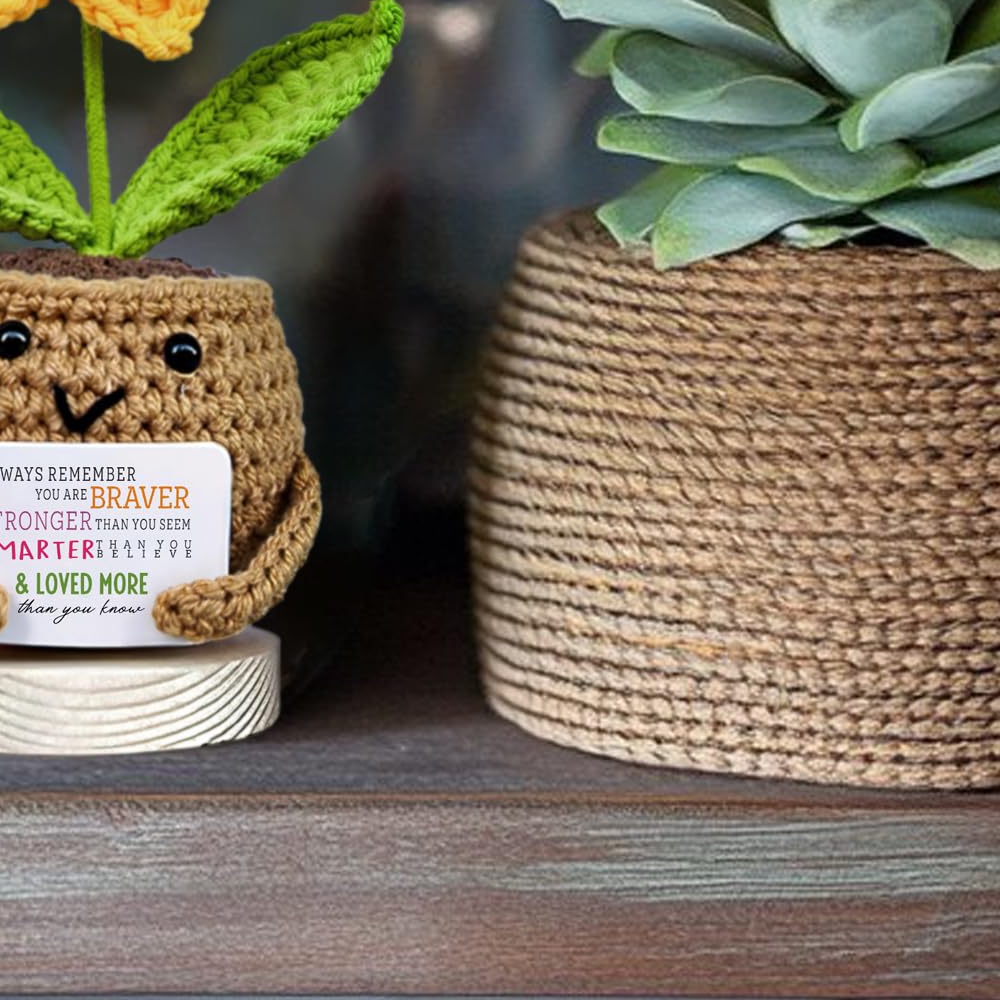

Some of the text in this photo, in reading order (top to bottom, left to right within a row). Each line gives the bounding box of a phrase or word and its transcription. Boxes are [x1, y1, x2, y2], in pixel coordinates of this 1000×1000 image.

[48, 466, 136, 482] REMEMBER
[35, 485, 190, 509] YOU ARE BRAVER
[95, 518, 129, 530] THAN
[132, 518, 156, 530] YOU
[159, 518, 191, 530] SEEM
[96, 539, 146, 549] THAN
[156, 539, 192, 549] YOU
[97, 549, 192, 558] BELIEVE
[15, 572, 148, 595] & LOVED MORE
[17, 599, 145, 625] than you know
